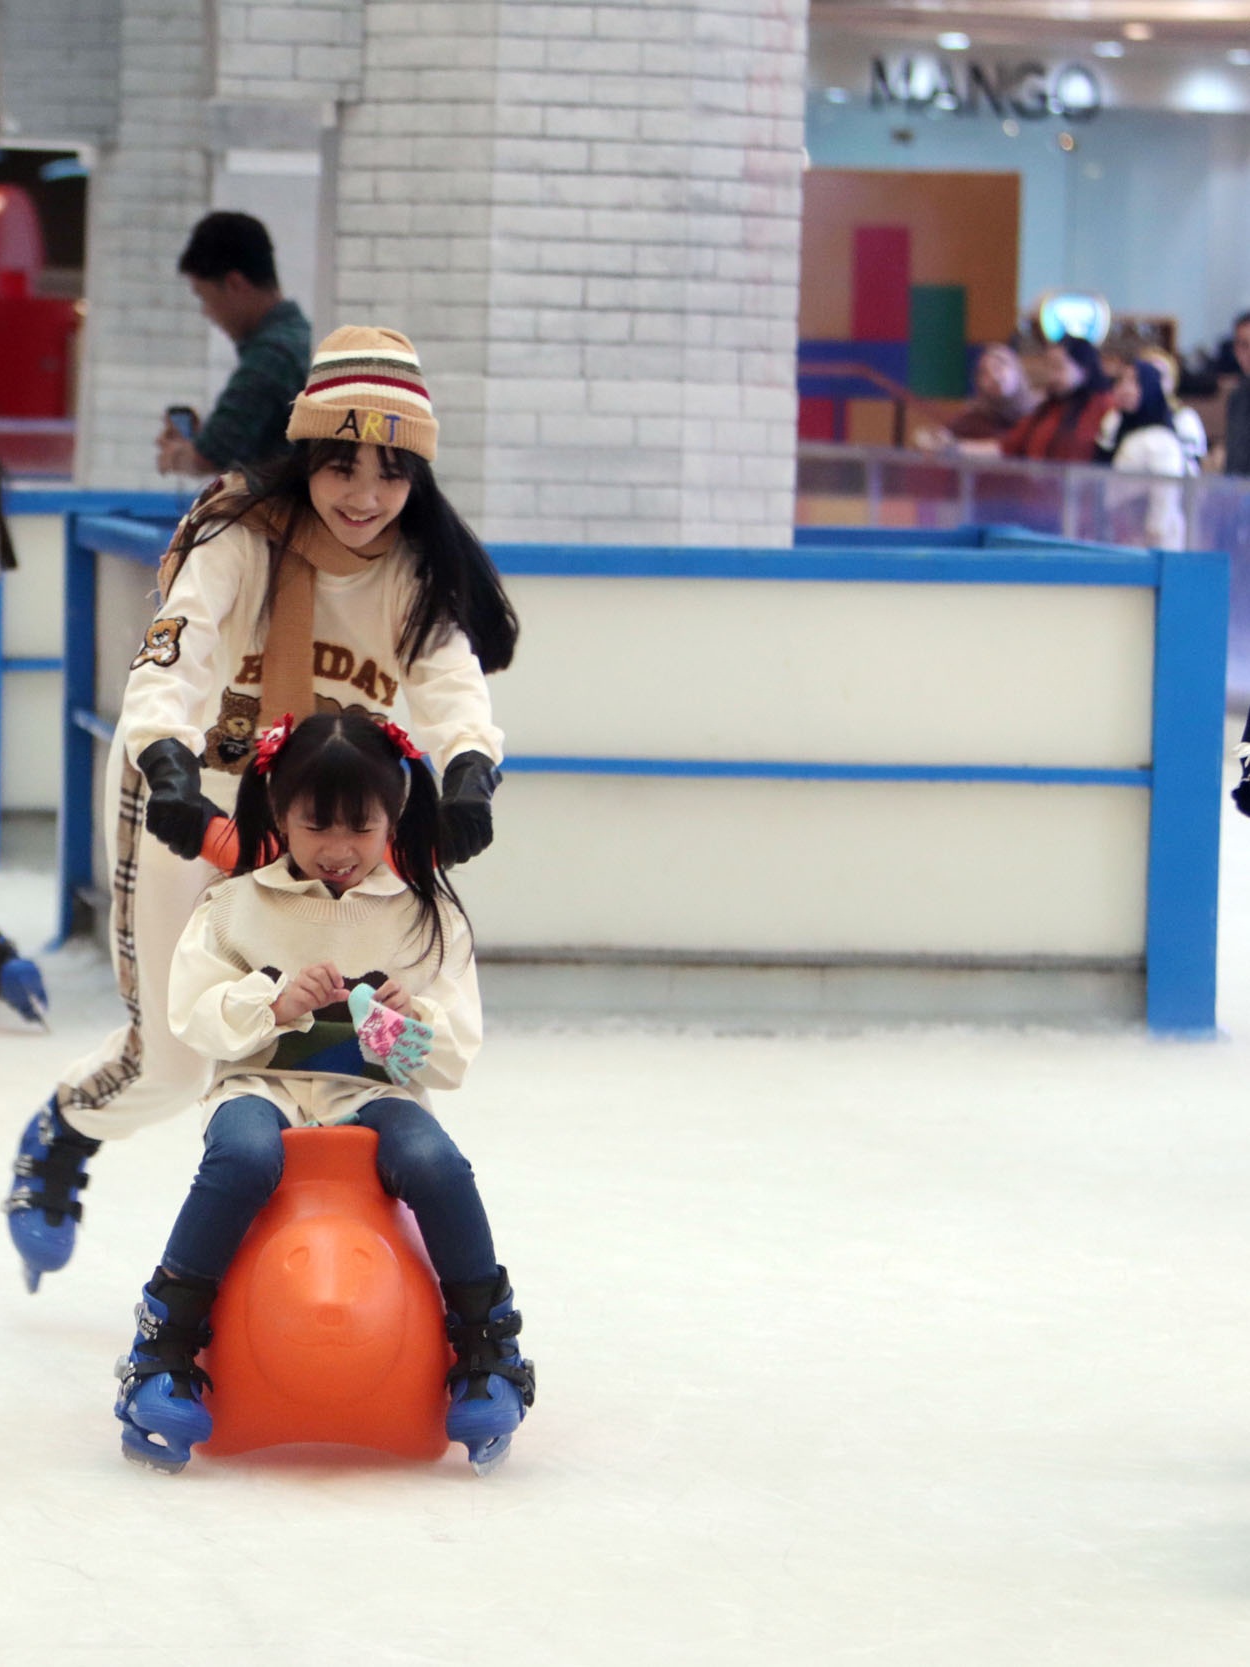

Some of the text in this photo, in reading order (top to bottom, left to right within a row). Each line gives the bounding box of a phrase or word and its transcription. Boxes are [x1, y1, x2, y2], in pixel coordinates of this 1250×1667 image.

[869, 57, 1100, 121] MANGO
[335, 408, 401, 443] ART
[235, 641, 399, 706] HIDAY
